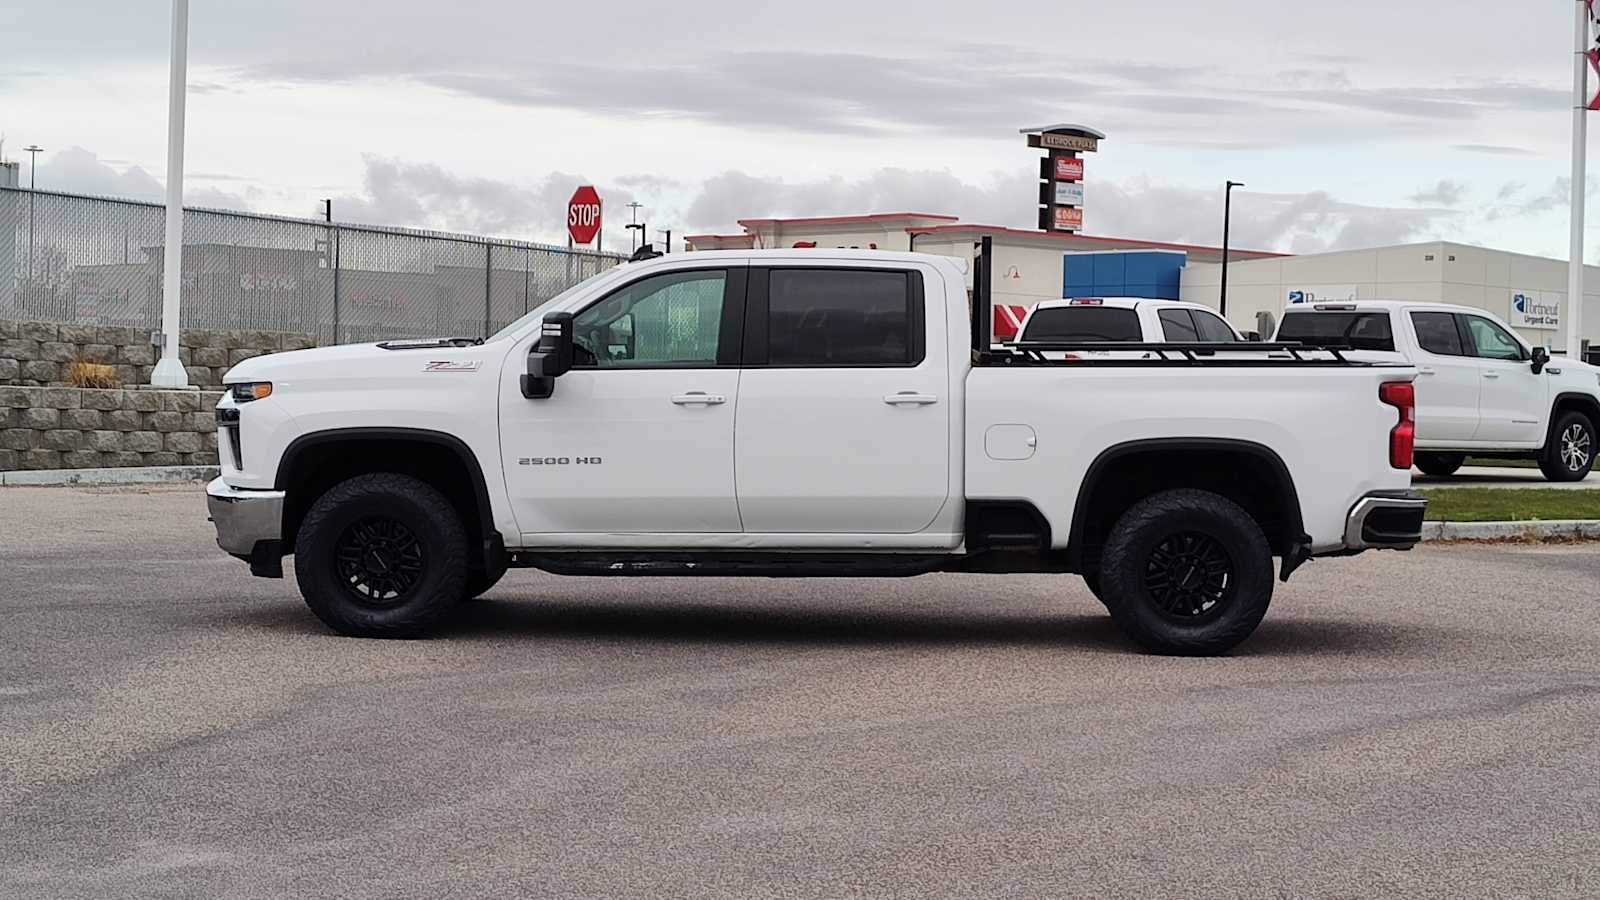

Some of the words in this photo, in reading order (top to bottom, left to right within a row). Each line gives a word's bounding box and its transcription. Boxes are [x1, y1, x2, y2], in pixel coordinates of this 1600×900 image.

[570, 204, 600, 226] STOP
[1526, 296, 1559, 316] Portneuf
[1525, 315, 1544, 325] Urgent
[1545, 316, 1558, 325] Care
[518, 457, 569, 465] 2500
[576, 457, 602, 465] HD
